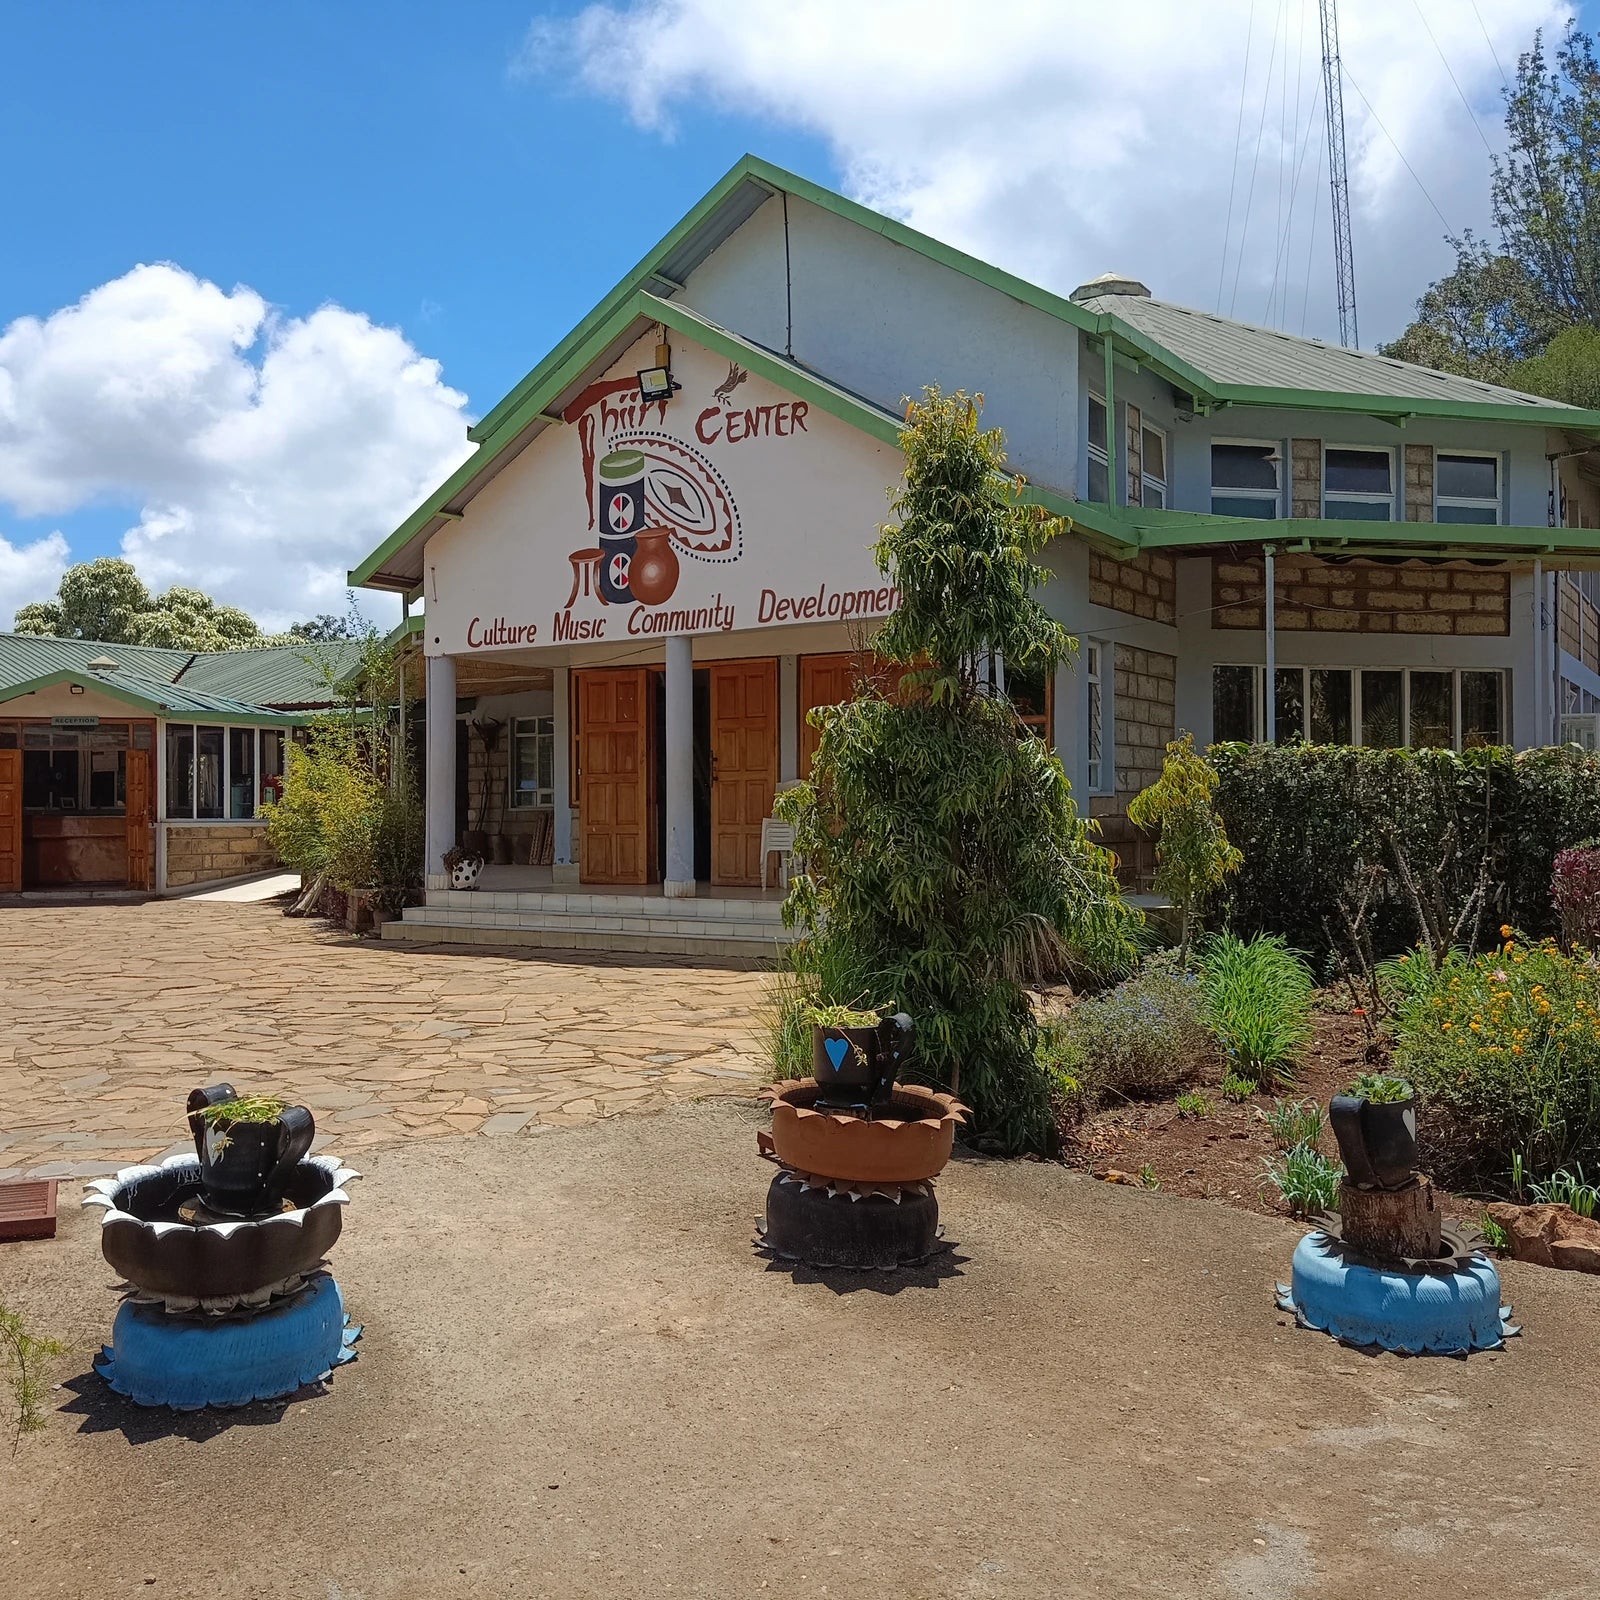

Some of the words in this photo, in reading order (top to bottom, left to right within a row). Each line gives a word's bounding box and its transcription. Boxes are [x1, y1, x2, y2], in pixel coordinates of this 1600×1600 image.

[695, 401, 809, 445] CENTER
[467, 616, 537, 648] Culture
[552, 609, 607, 642] Music
[627, 592, 735, 635] Community
[758, 582, 904, 623] Developmen
